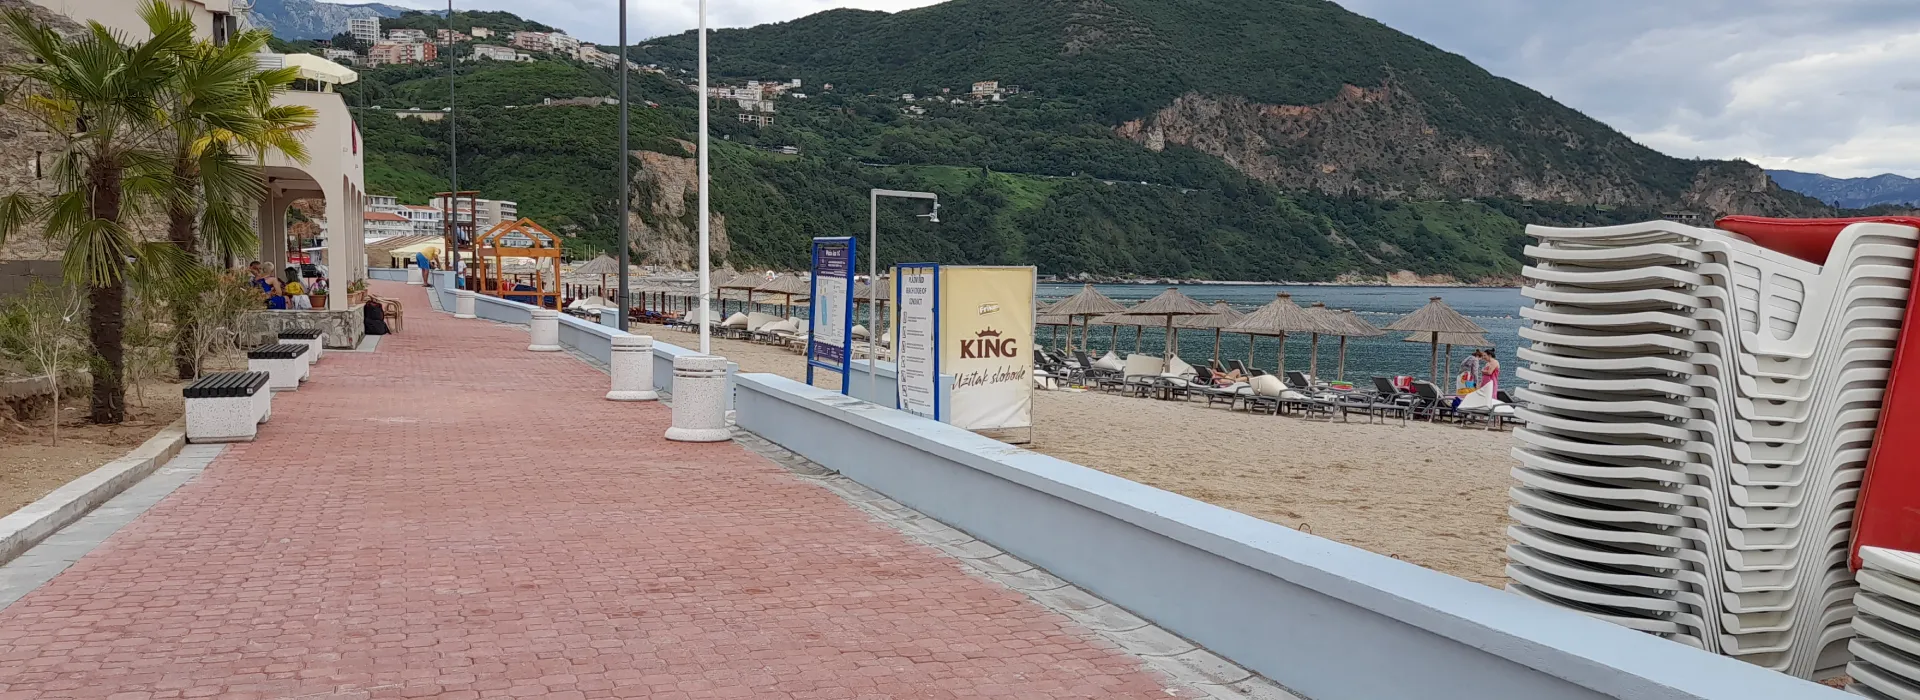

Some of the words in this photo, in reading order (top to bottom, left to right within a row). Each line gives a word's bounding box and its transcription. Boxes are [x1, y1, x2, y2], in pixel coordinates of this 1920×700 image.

[960, 338, 1018, 359] KING
[952, 368, 989, 390] Užitak
[990, 365, 1026, 385] slobode
